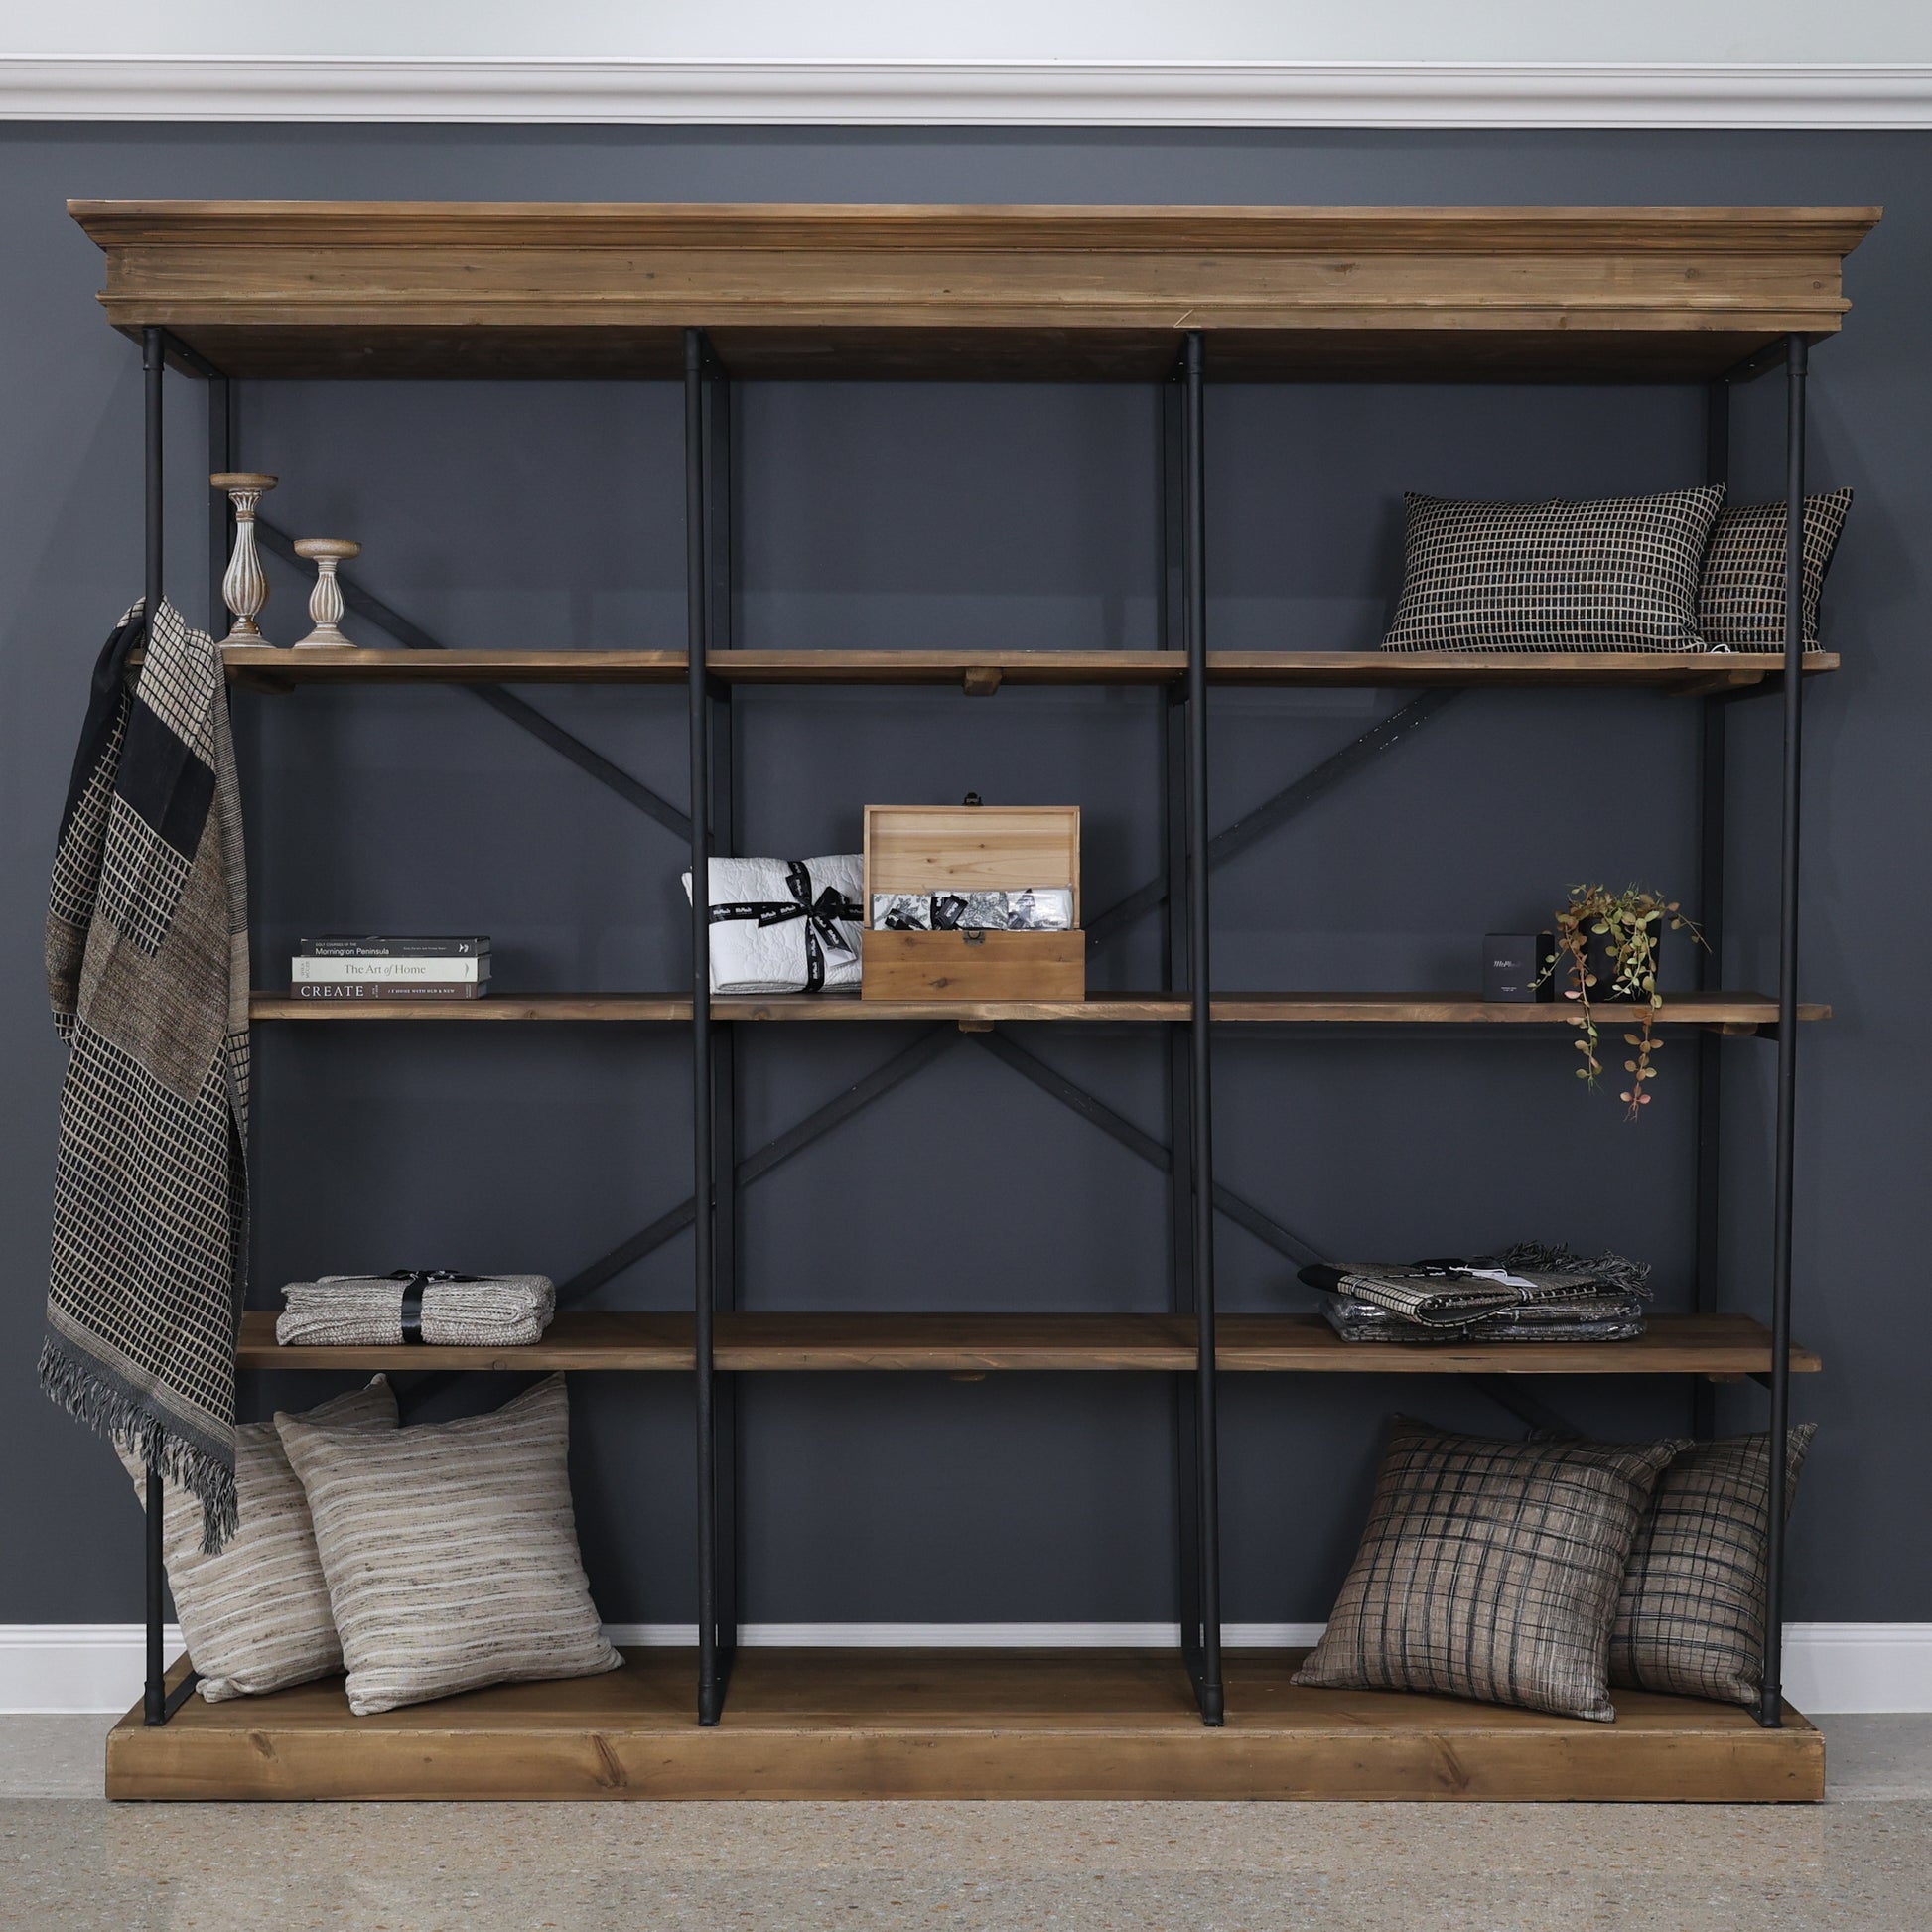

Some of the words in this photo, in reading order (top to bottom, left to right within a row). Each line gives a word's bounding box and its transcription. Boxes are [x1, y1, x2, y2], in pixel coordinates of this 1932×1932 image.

[315, 947, 355, 956] Mornington
[344, 964, 364, 974] The
[364, 964, 381, 974] Art
[384, 963, 394, 976] of
[395, 964, 427, 974] Home
[300, 985, 364, 997] CREATE
